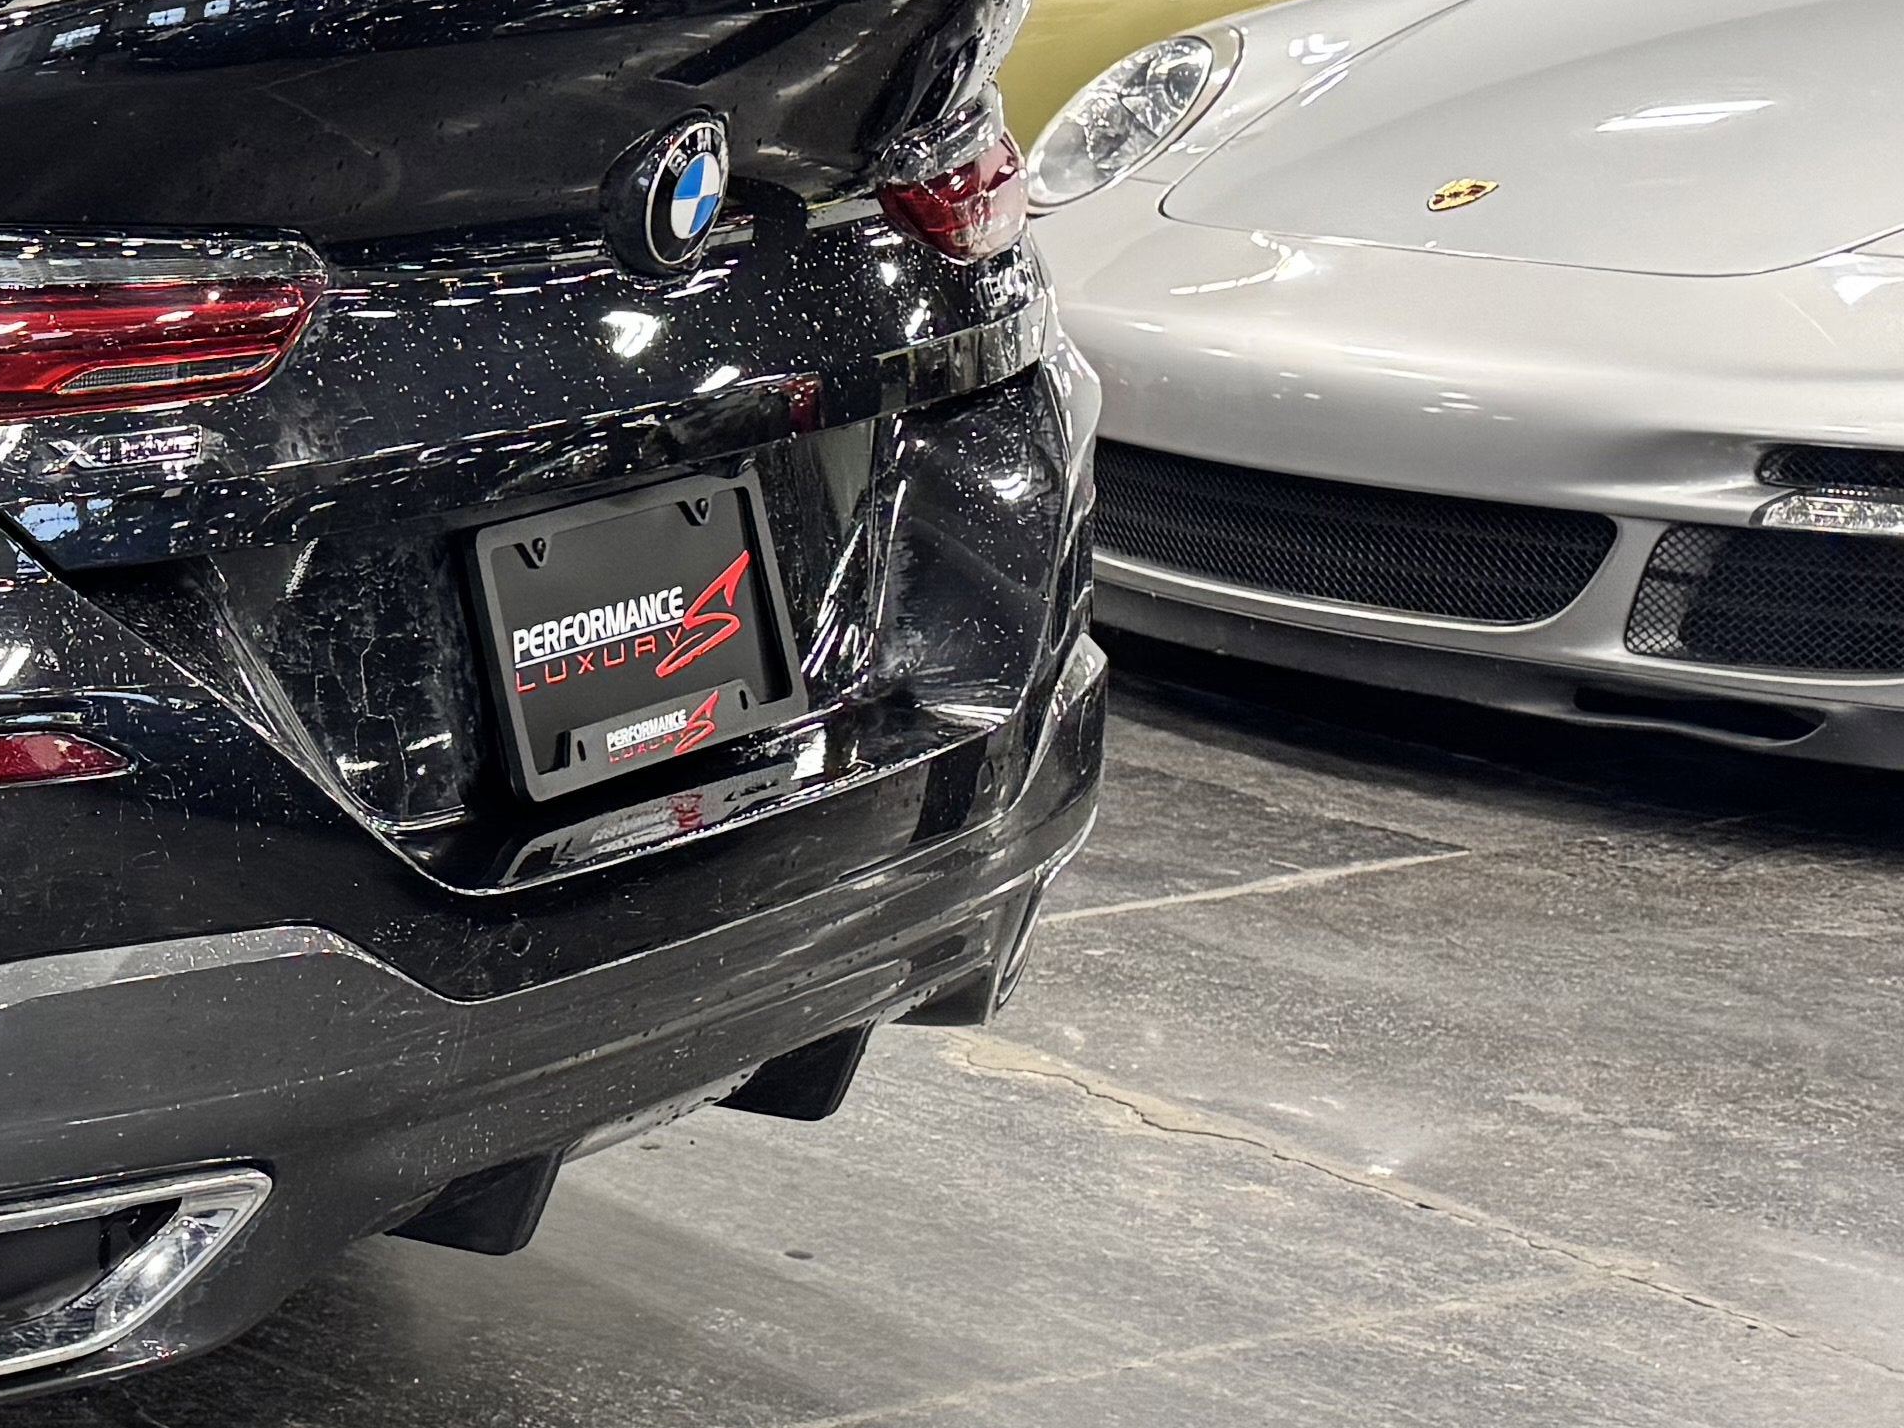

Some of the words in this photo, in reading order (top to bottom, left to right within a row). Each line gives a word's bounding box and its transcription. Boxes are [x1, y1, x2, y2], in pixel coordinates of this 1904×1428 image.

[513, 585, 685, 664] PERFORMANCE
[516, 627, 683, 693] LUXURY
[607, 708, 688, 750] PERFORMANCE
